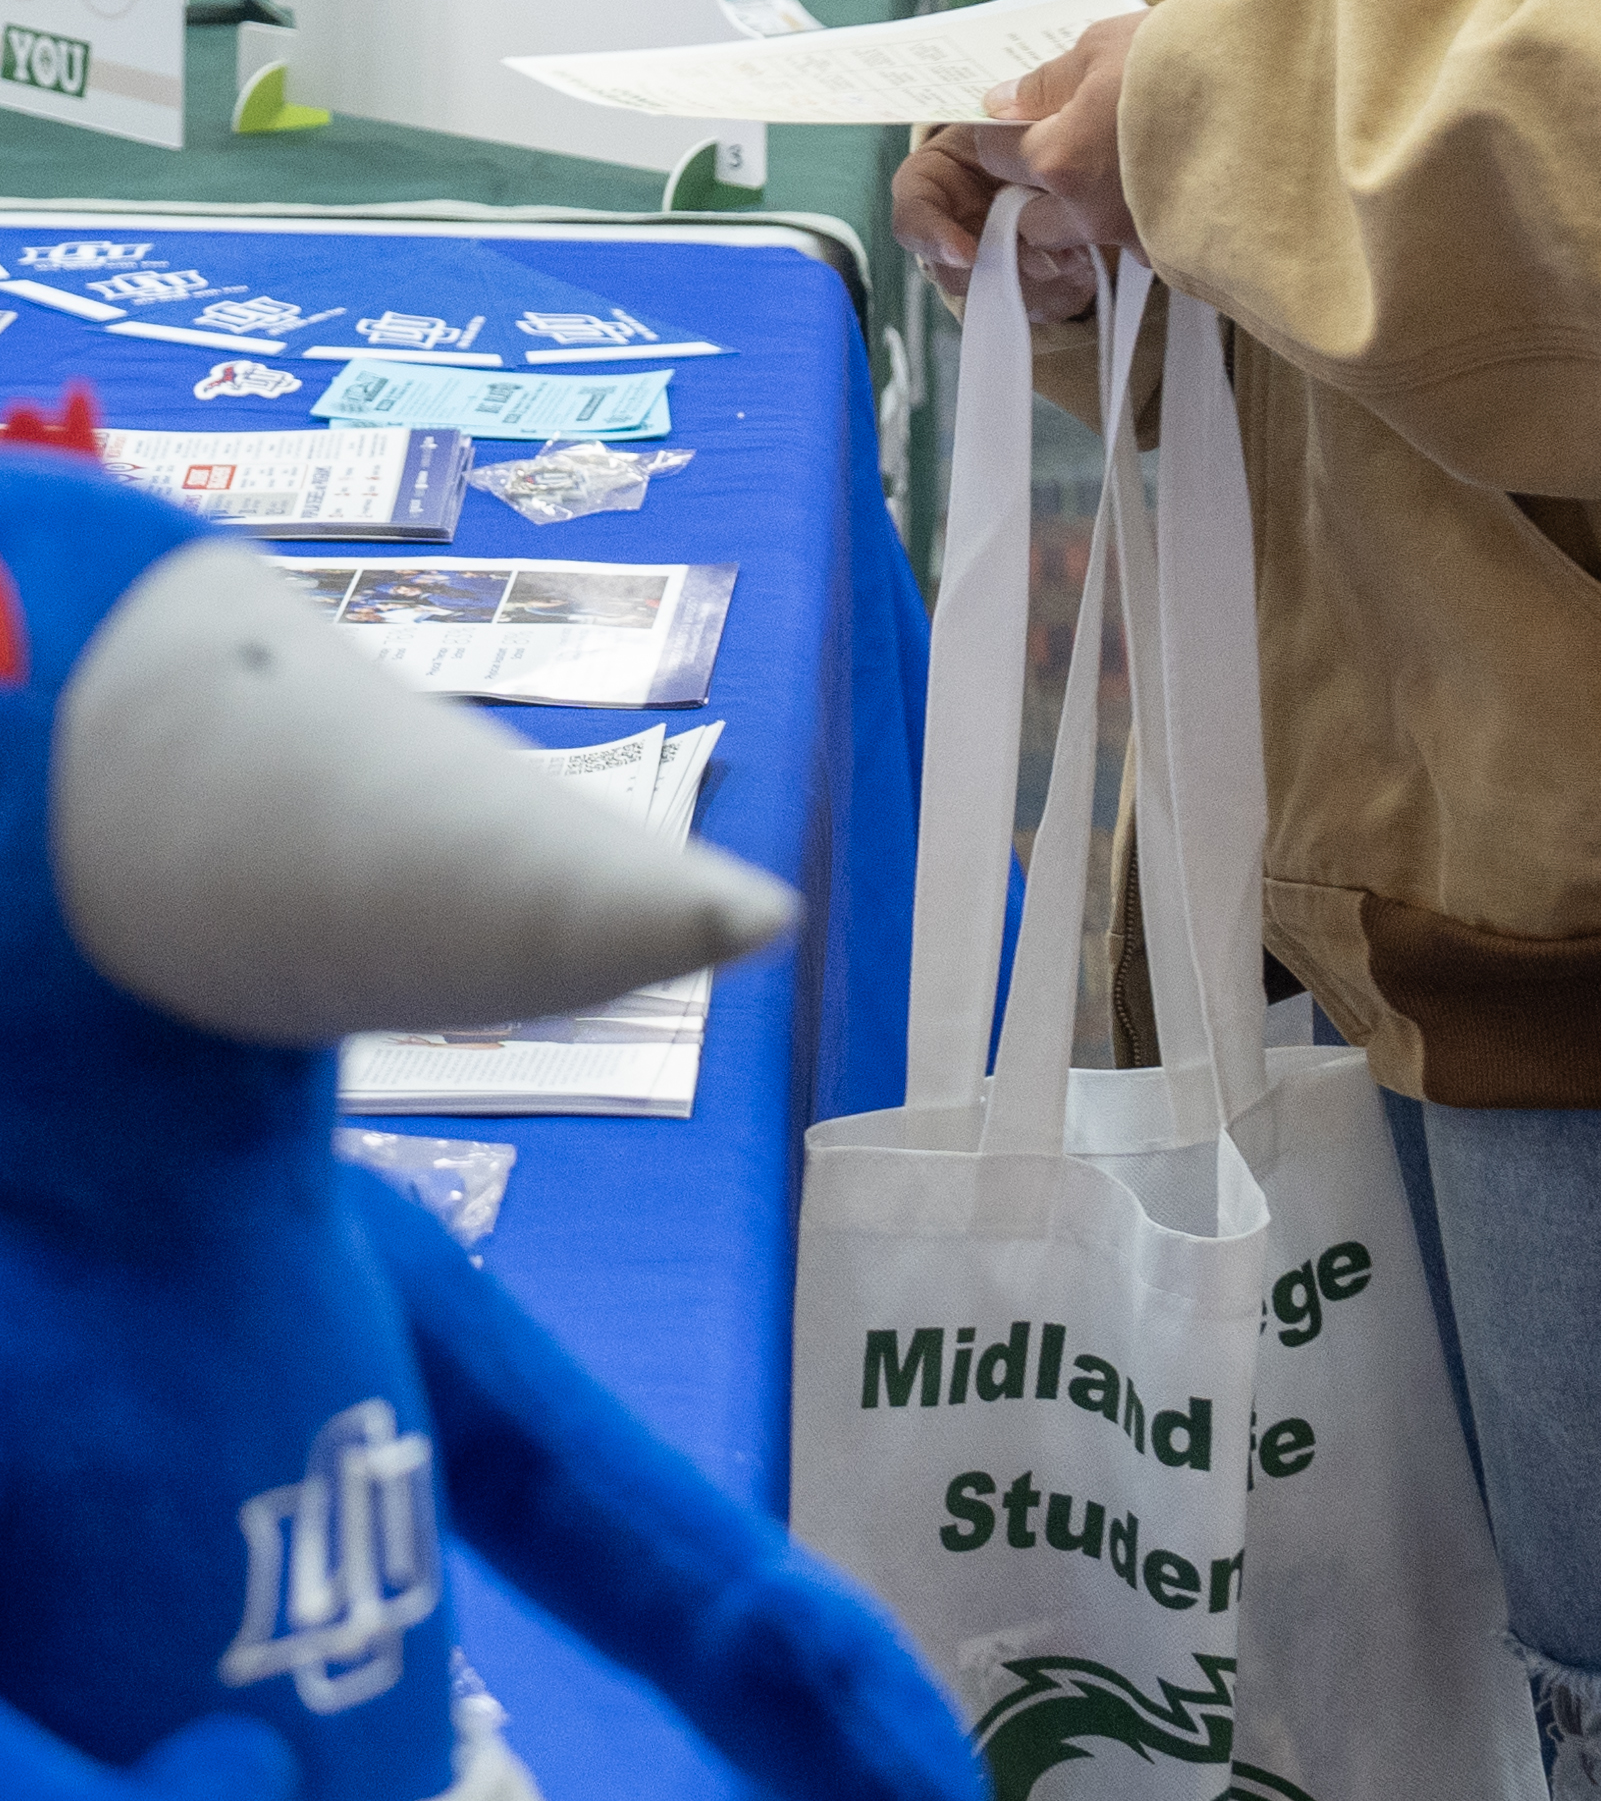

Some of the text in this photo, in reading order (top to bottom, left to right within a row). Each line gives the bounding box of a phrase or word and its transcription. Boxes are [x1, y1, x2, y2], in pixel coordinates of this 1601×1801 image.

[6, 29, 86, 95] YOU
[861, 1320, 1213, 1471] Midland
[938, 1469, 1246, 1614] Studen
